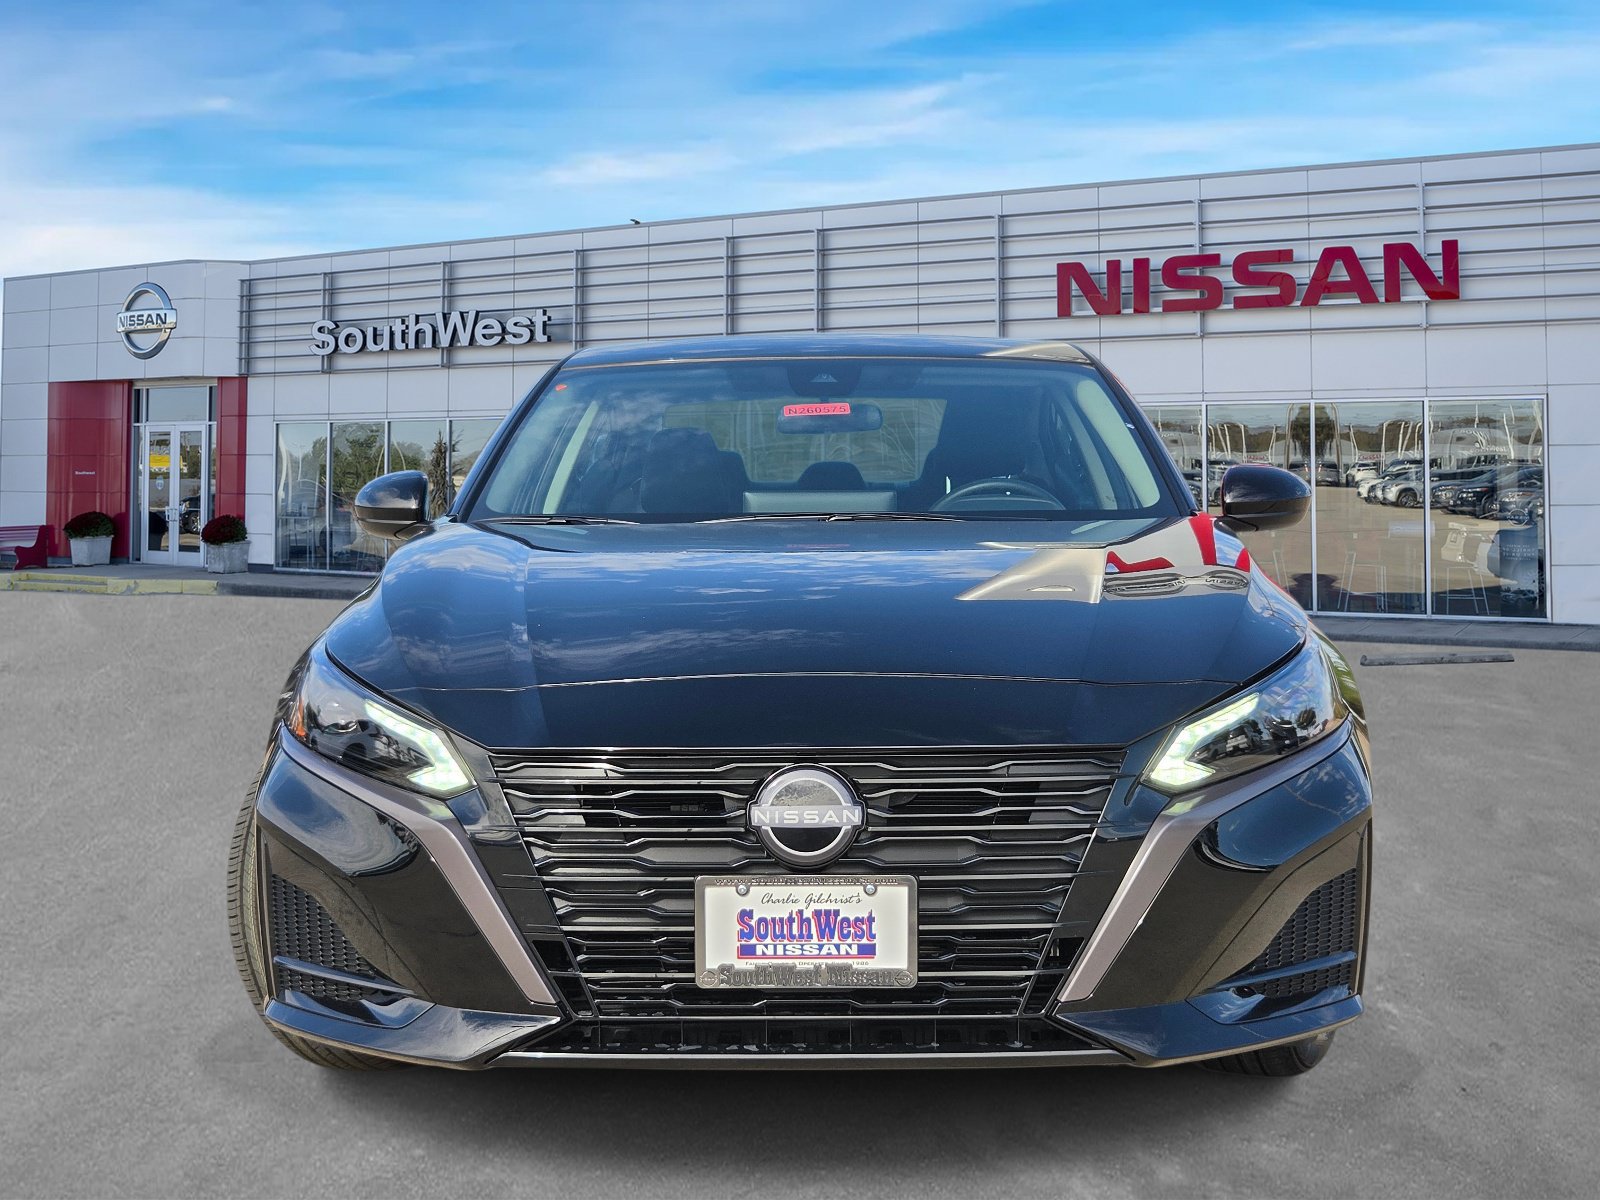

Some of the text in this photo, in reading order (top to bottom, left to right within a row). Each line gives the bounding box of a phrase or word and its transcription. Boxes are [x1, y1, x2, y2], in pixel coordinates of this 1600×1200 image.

[1057, 239, 1460, 318] NISSAN
[119, 312, 167, 328] NISSAN
[309, 308, 552, 356] SouthWest
[788, 405, 846, 415] N260575
[754, 809, 859, 824] NISSAN
[761, 892, 863, 910] Charlie Gilchrist's
[737, 908, 876, 943] SouthWest
[755, 943, 858, 956] NISSAN
